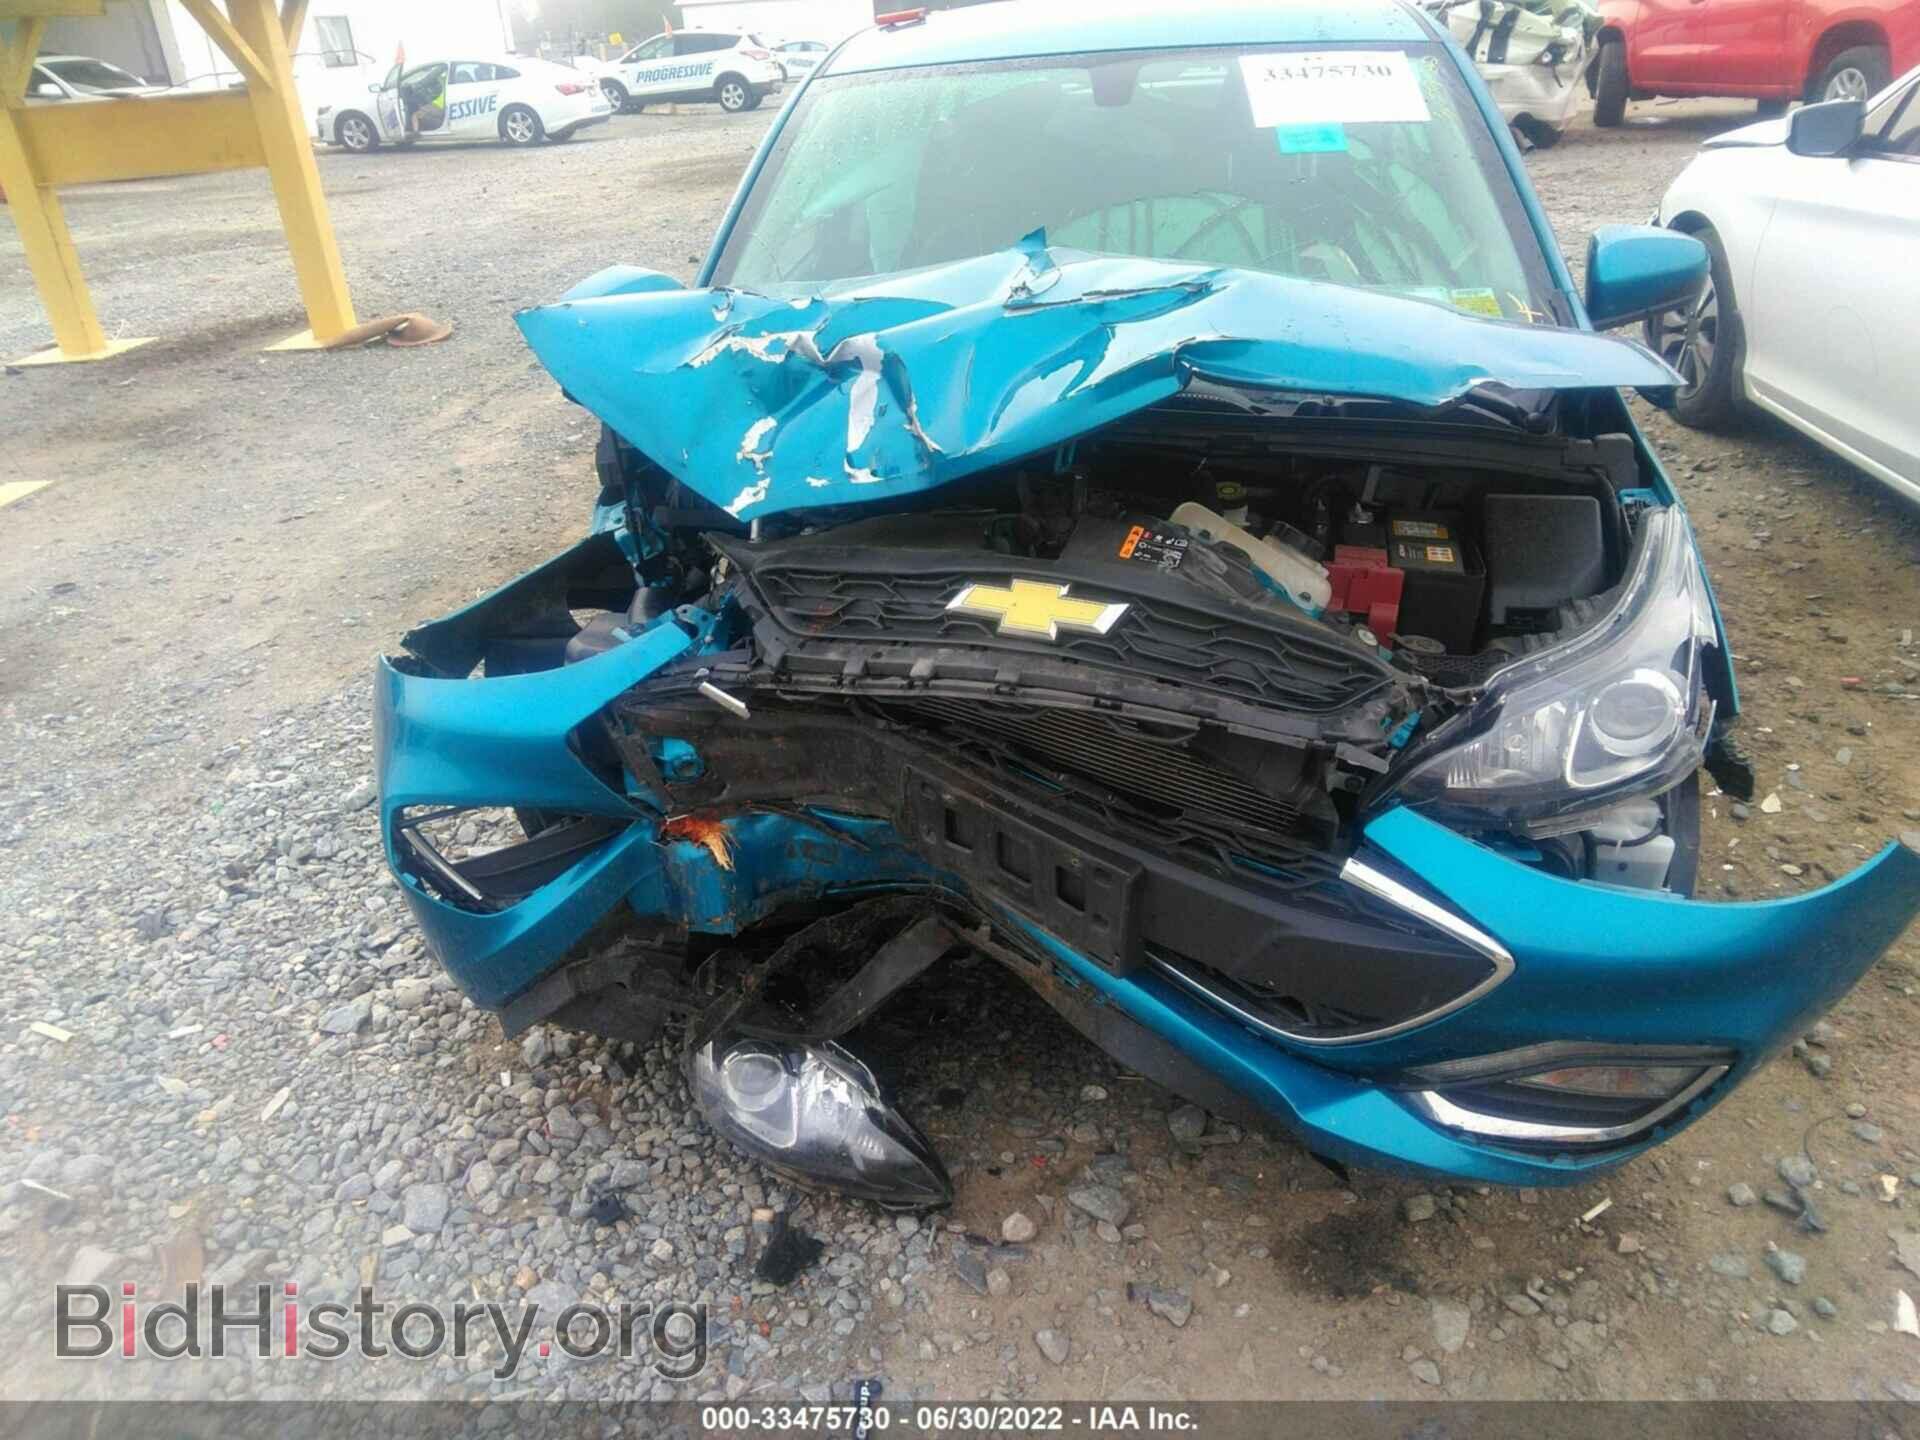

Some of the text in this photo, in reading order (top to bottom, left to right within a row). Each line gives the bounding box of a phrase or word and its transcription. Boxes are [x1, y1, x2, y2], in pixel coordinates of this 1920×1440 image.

[636, 63, 712, 83] PROGRESSIVE
[1264, 64, 1392, 82] 33475730
[448, 95, 497, 120] ESSIVE
